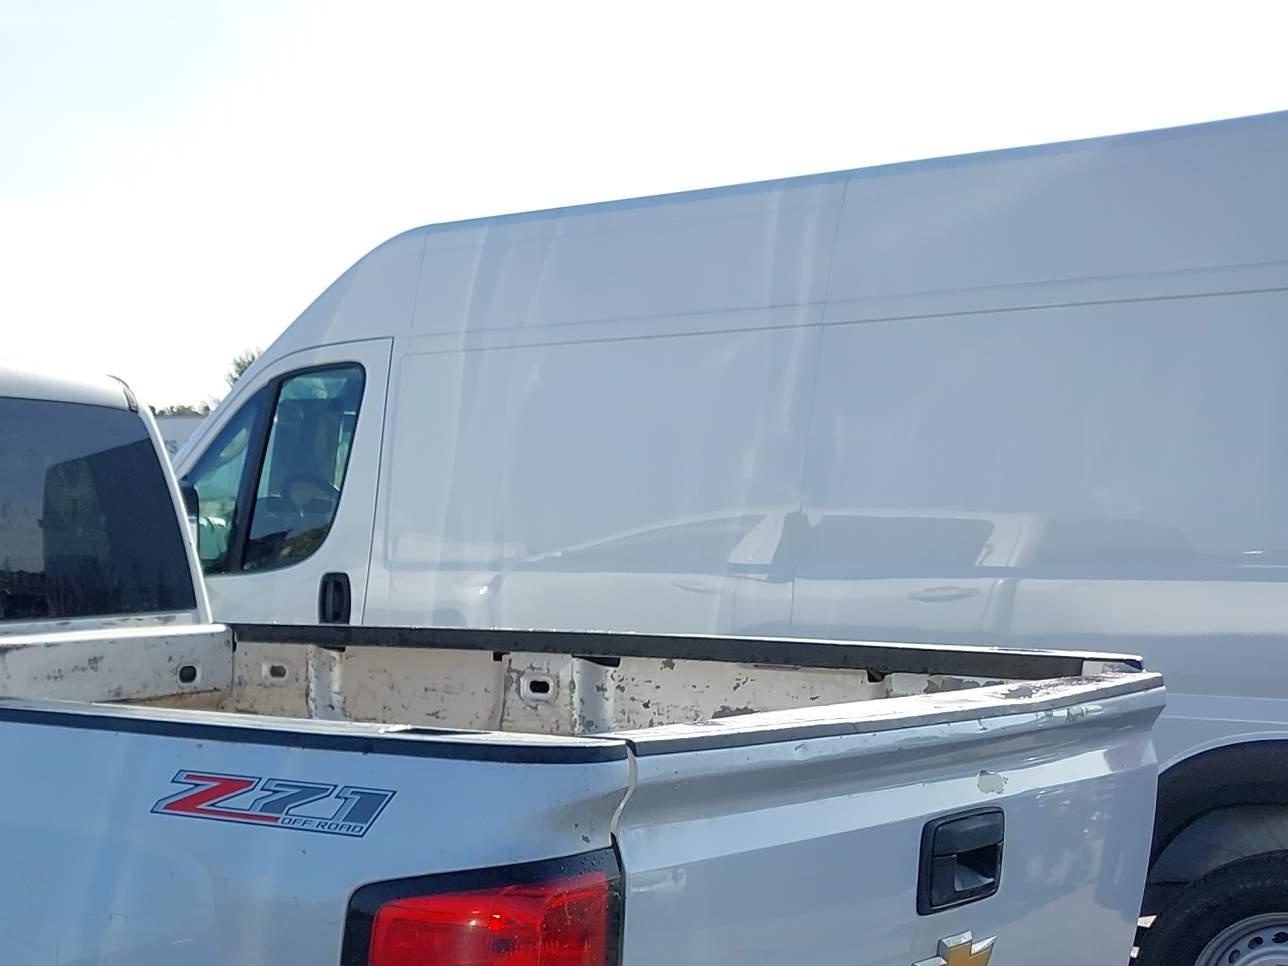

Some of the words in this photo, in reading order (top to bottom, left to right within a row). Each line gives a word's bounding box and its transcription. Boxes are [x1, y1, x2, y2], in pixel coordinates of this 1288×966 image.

[151, 769, 397, 832] Z71
[281, 817, 314, 827] OFF
[316, 821, 365, 833] ROAD
